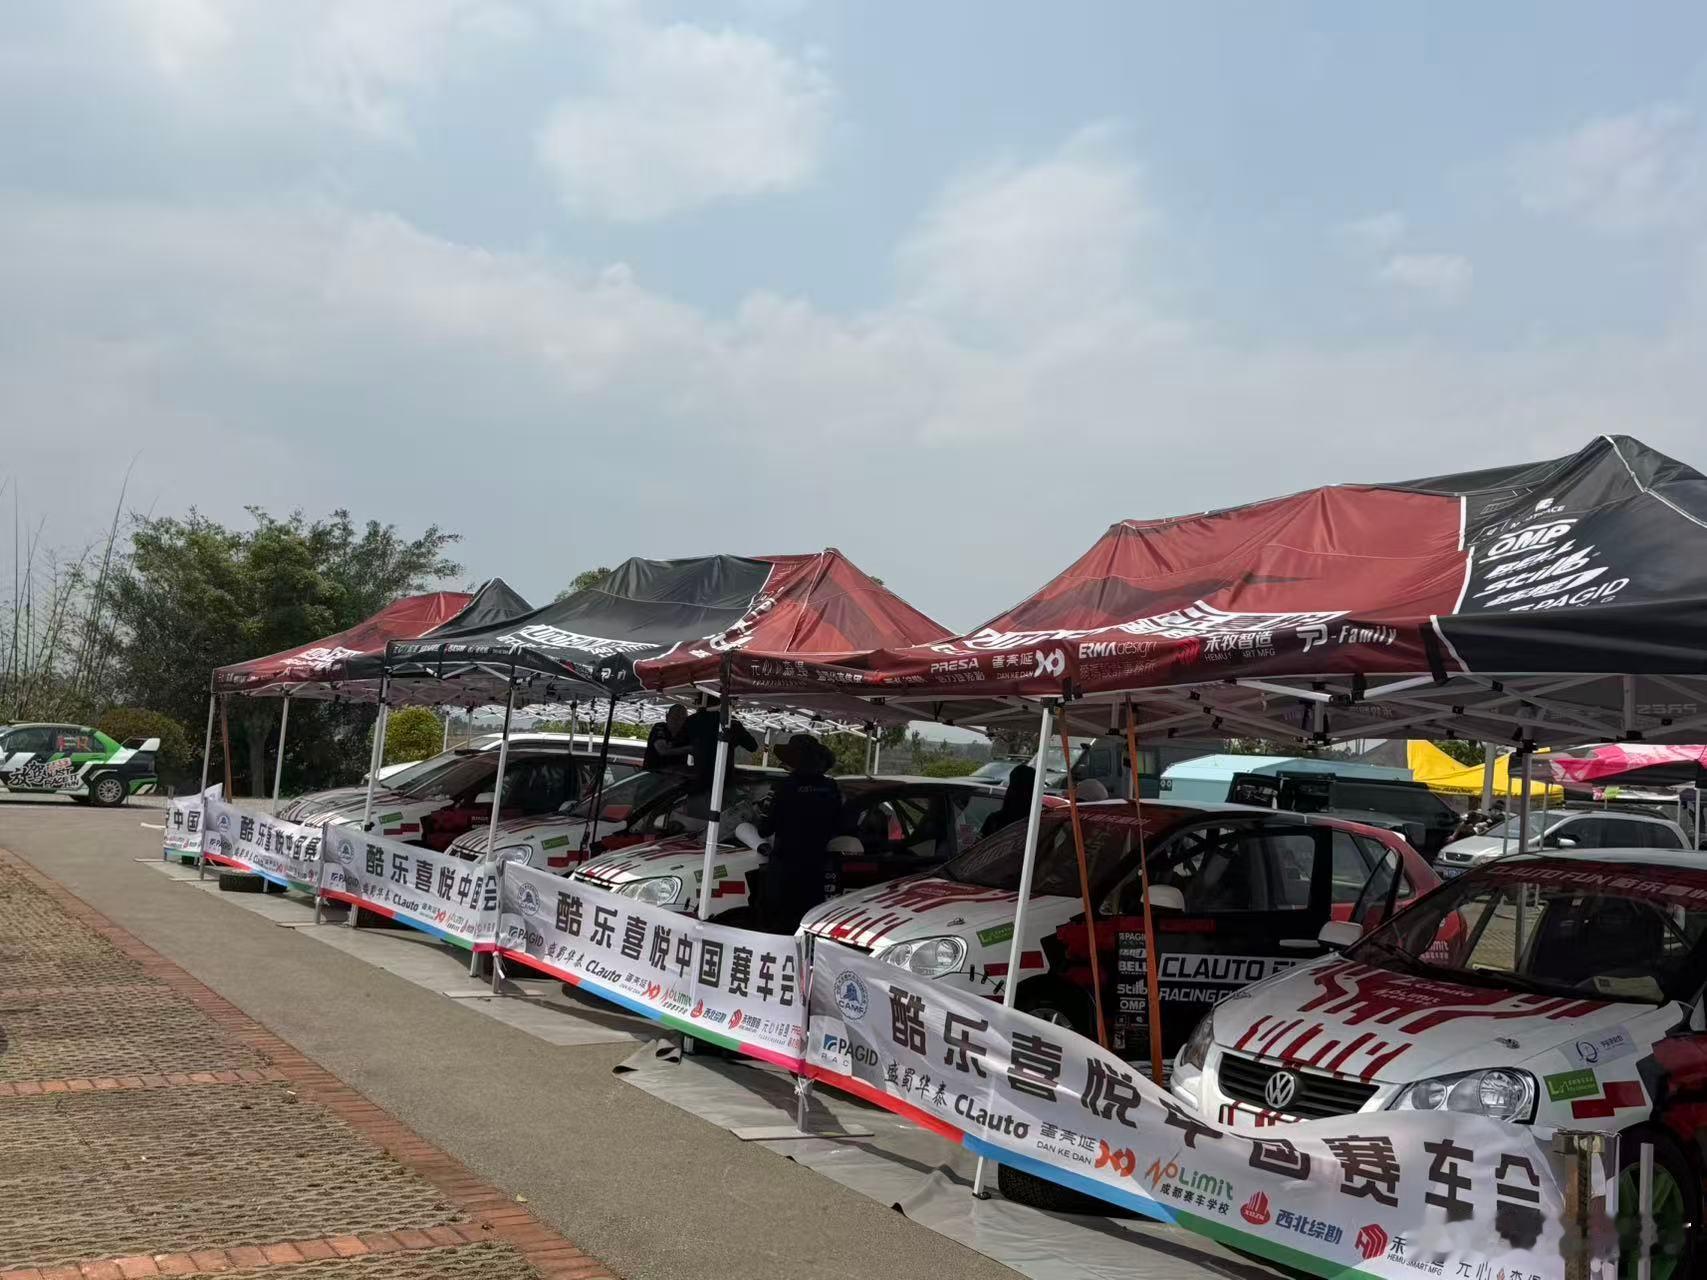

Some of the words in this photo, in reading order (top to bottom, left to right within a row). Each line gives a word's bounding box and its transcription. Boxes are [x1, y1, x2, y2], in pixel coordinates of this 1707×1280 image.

[1487, 523, 1573, 558] OMP
[1533, 578, 1631, 610] PAGID
[930, 657, 980, 674] PRESA
[518, 928, 544, 947] PAGID
[555, 890, 795, 1006] 酷乐喜悦中国赛车会
[585, 959, 622, 983] CLauto
[1161, 956, 1266, 981] CLAUTO
[1119, 1000, 1146, 1011] OMP
[1158, 988, 1219, 1003] RACING
[838, 1038, 879, 1067] PAGID
[954, 1093, 1032, 1140] CLauto
[1036, 1140, 1057, 1153] DAN
[1057, 1147, 1071, 1158] KE
[1072, 1152, 1093, 1165] DAN
[1160, 1182, 1231, 1216] 成都赛车学校
[1387, 1253, 1405, 1265] HEMU
[1428, 1265, 1443, 1277] MFG
